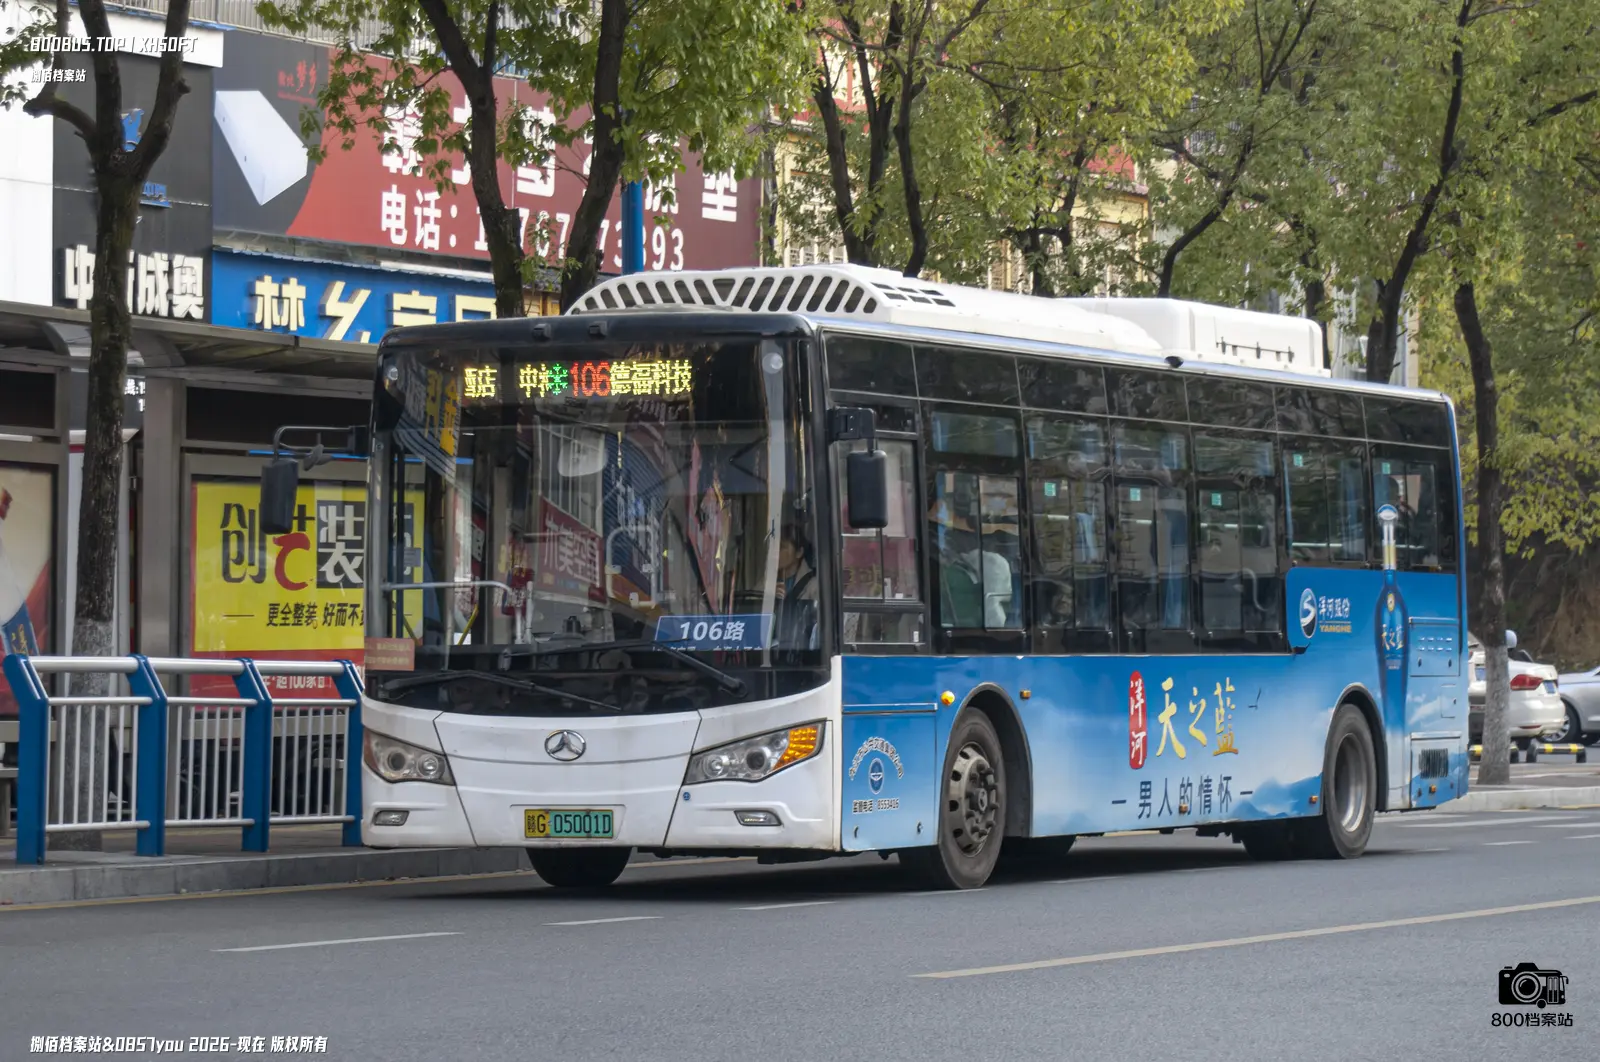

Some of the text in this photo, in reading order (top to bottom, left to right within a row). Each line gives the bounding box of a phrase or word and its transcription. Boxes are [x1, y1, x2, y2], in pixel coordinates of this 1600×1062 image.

[570, 362, 611, 397] 106
[266, 602, 365, 628] 更全整装 好而不
[1318, 595, 1351, 619] 洋河股份
[680, 621, 746, 641] 106路
[1130, 678, 1147, 766] 洋河
